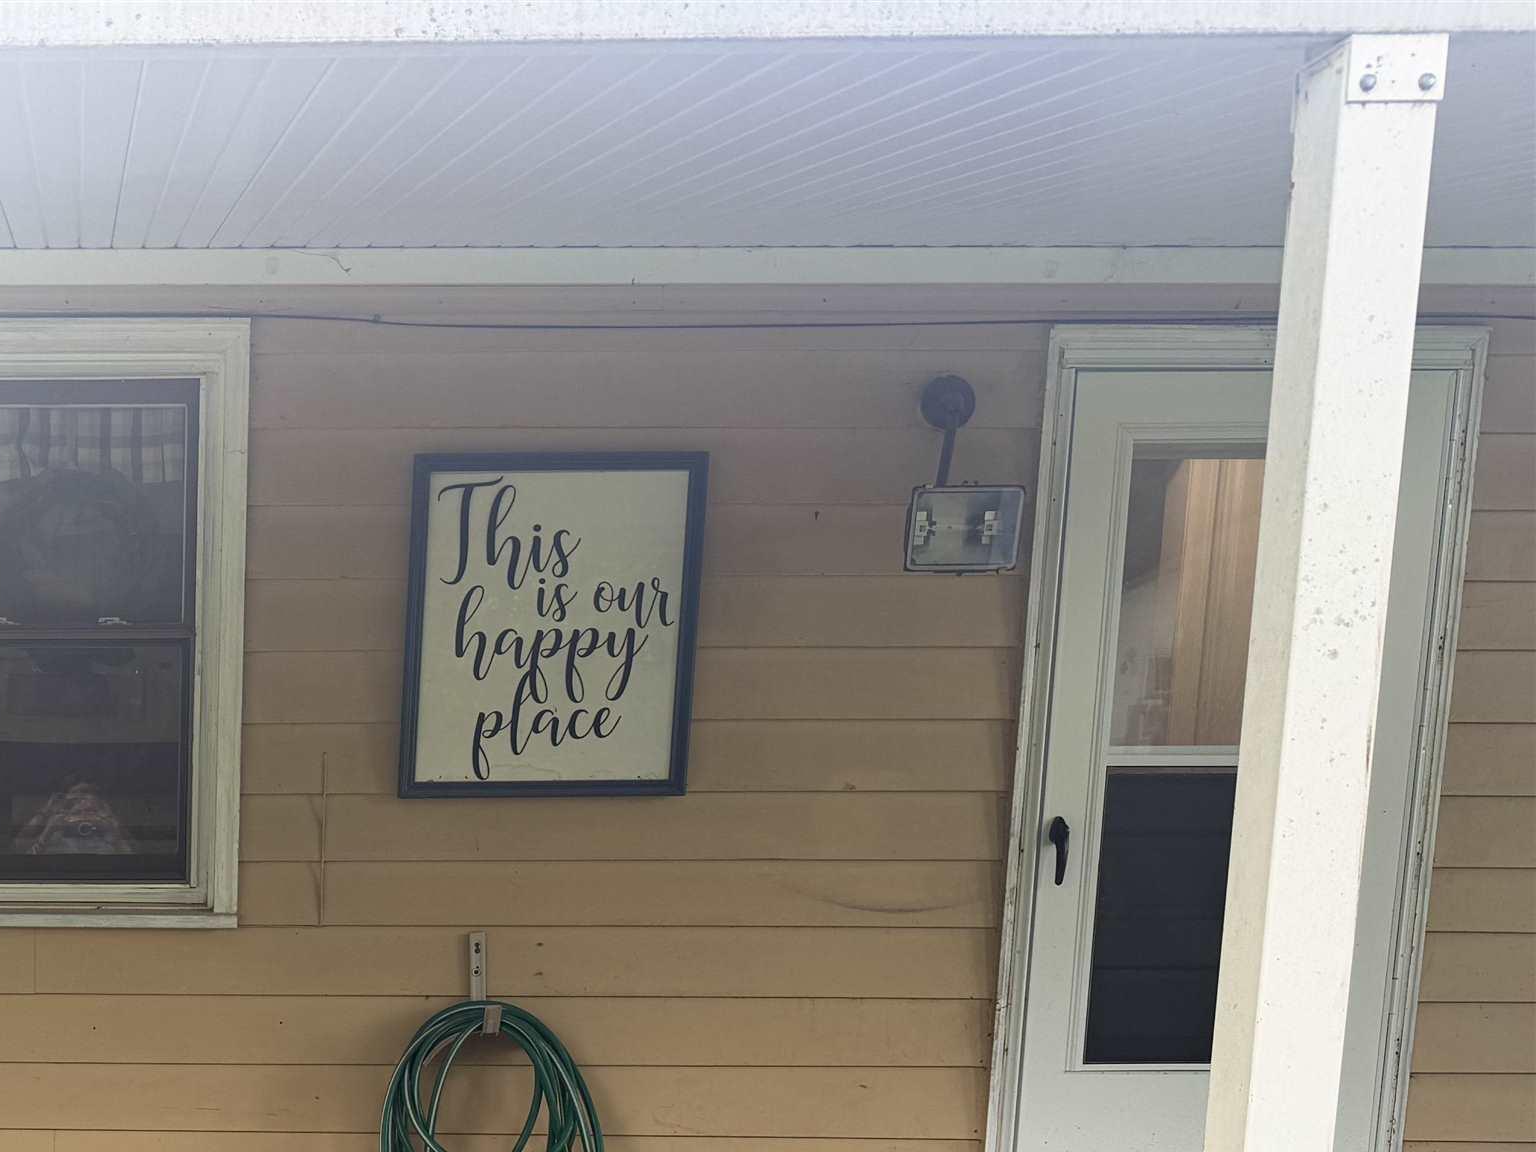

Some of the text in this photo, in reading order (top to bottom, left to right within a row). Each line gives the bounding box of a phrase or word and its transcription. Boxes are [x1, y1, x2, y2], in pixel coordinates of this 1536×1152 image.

[438, 476, 581, 590] This
[455, 585, 649, 704] happy
[536, 577, 675, 629] is our
[472, 667, 622, 781] place
